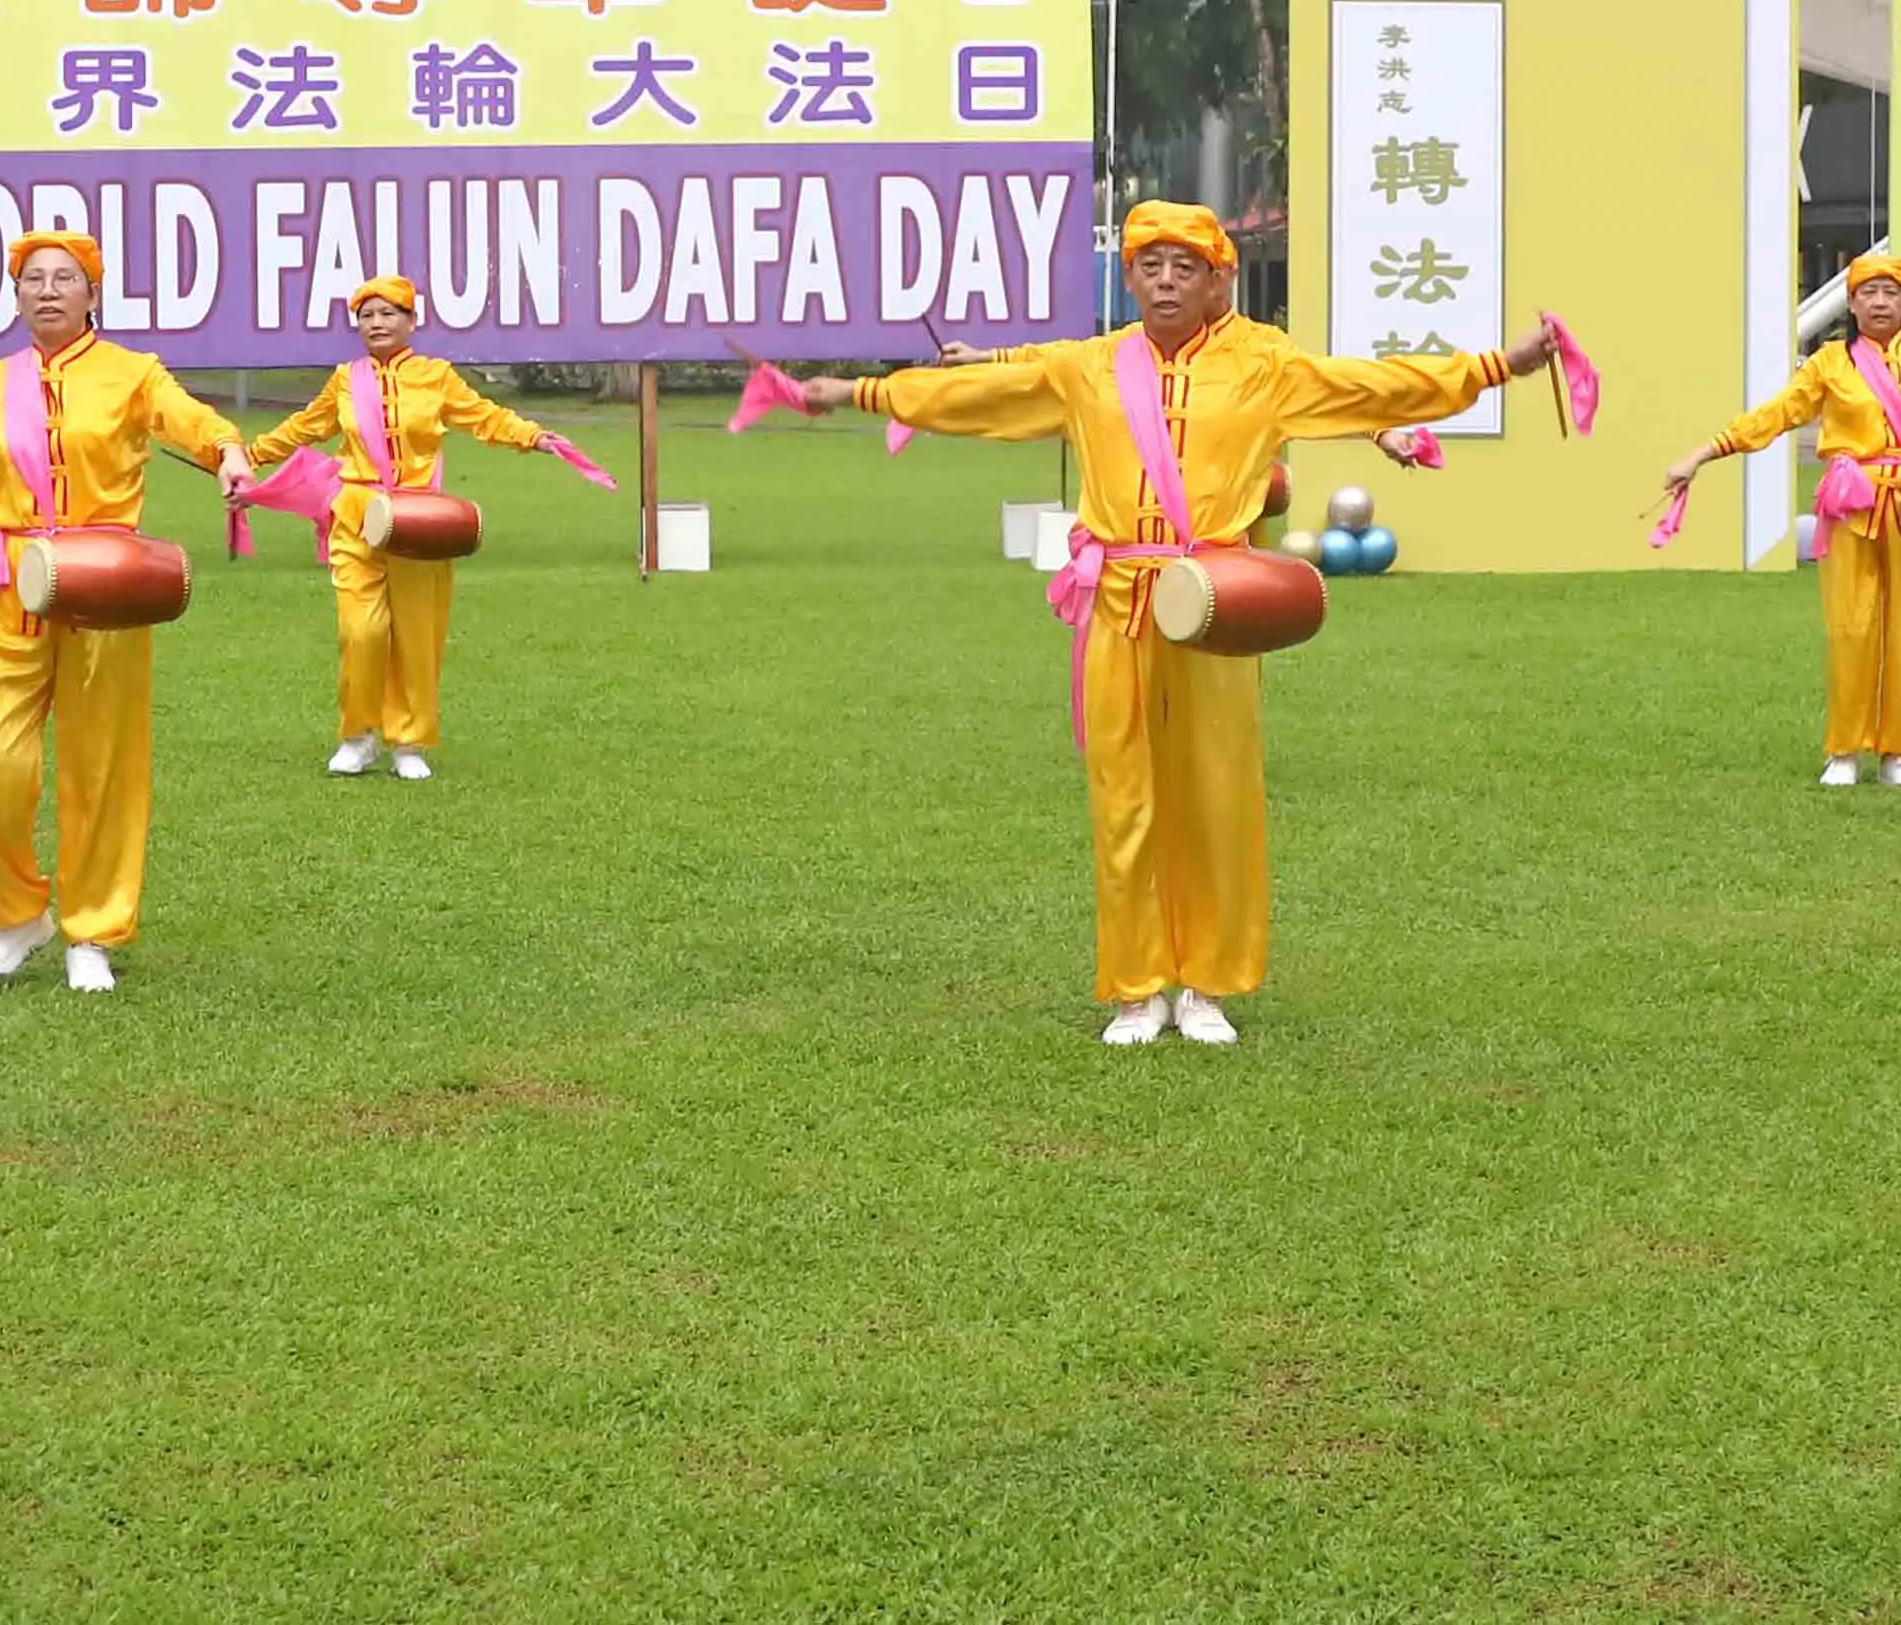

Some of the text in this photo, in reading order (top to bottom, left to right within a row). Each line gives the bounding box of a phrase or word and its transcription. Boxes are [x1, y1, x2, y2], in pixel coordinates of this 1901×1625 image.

[1377, 23, 1412, 114] 李洪志
[256, 179, 561, 328] FALUN
[598, 177, 848, 325] DAFA
[881, 175, 1071, 322] DAY
